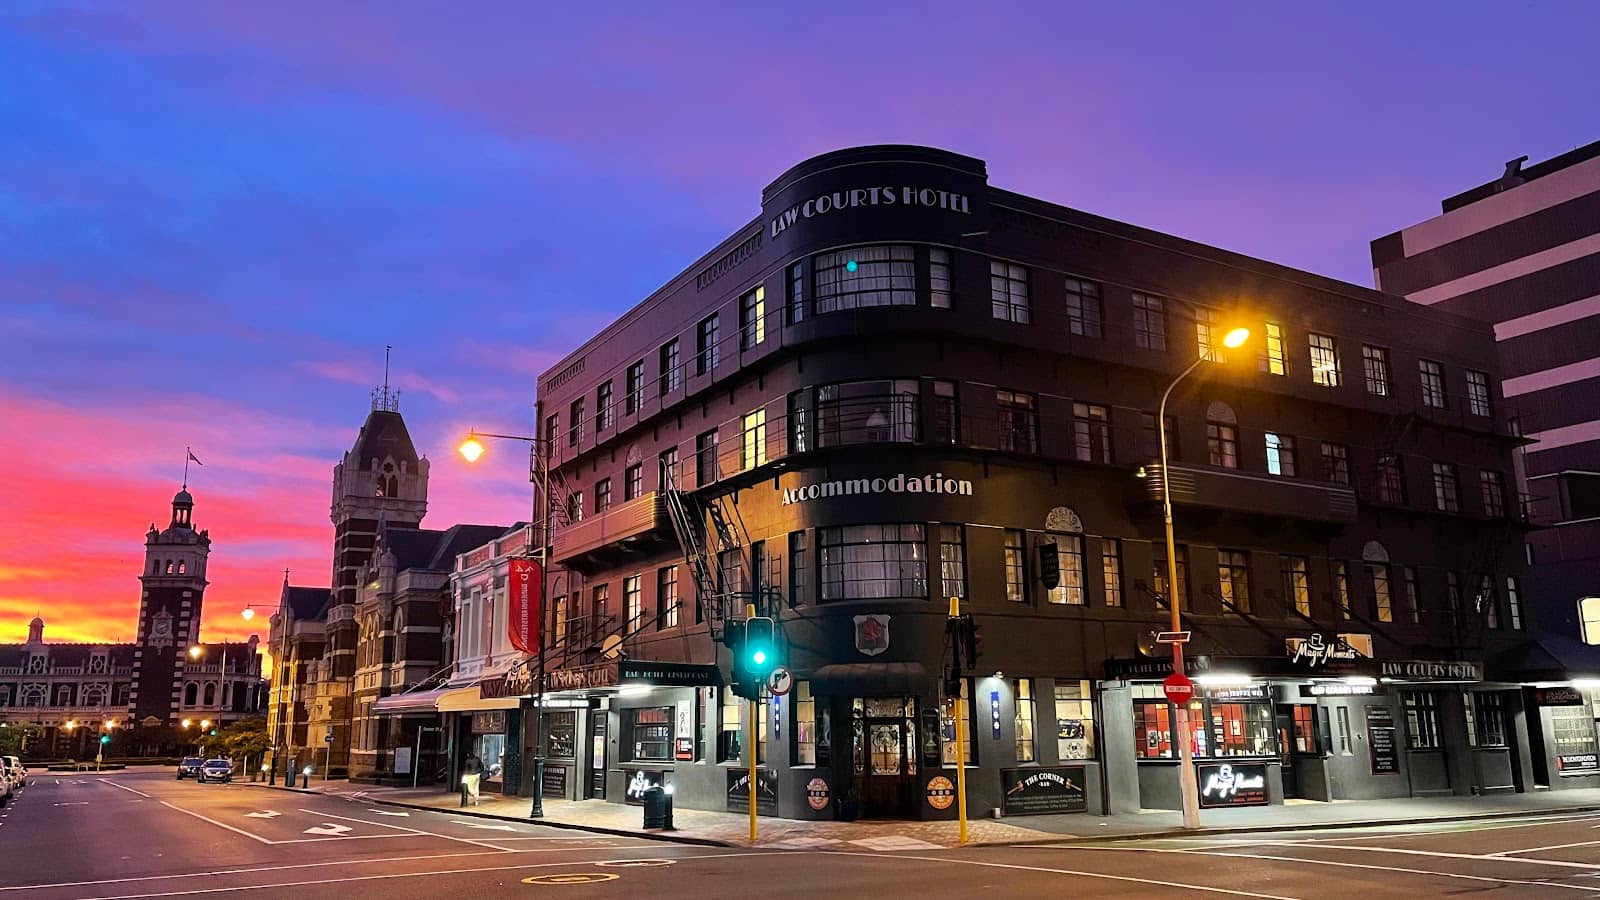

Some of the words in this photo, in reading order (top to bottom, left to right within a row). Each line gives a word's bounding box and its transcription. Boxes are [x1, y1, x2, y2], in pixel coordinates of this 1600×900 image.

[771, 205, 800, 237] LAW
[802, 187, 896, 218] COURTS
[903, 186, 972, 215] HOTEL
[781, 472, 973, 506] Accommodation
[1293, 642, 1324, 667] Magic
[1025, 774, 1039, 786] THE
[1038, 772, 1065, 785] CORNER
